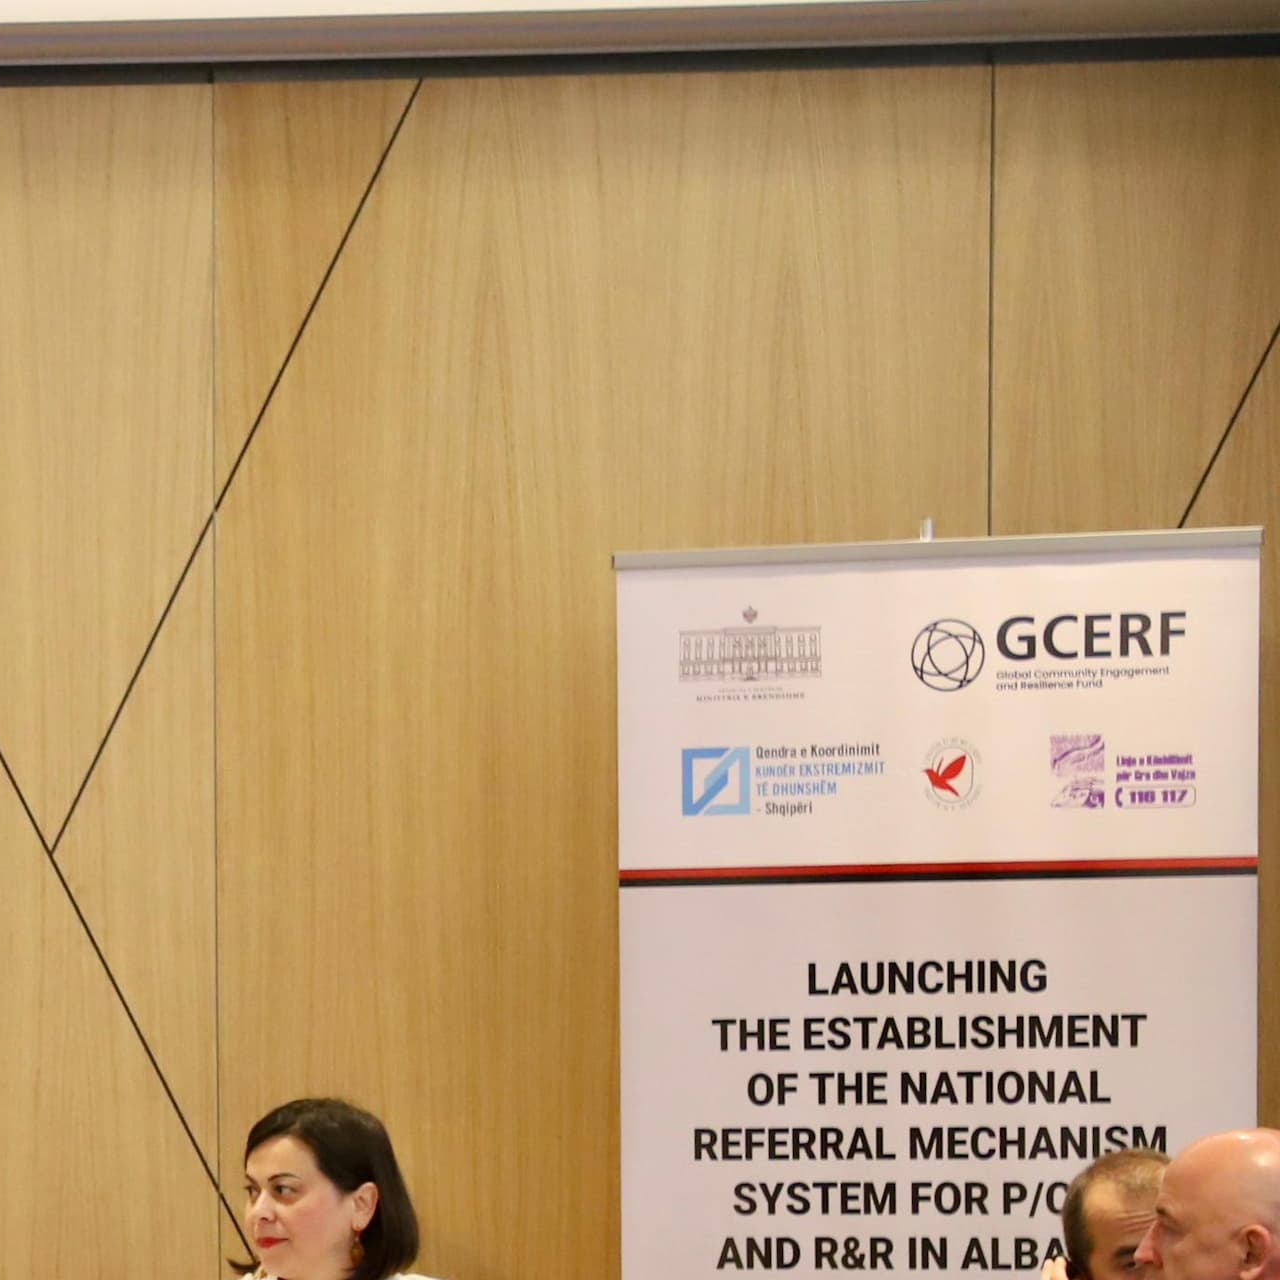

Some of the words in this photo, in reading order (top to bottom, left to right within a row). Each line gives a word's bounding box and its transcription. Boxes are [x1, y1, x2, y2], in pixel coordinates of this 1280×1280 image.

[996, 611, 1186, 661] GCERF
[996, 668, 1032, 680] Global
[1034, 667, 1098, 679] Community
[1100, 666, 1169, 679] Engagement
[996, 680, 1017, 691] and
[1020, 680, 1074, 690] Resilience
[1076, 679, 1103, 688] Fund
[756, 745, 796, 759] Qendra
[800, 748, 807, 758] e
[810, 742, 880, 757] Koordinimit
[800, 761, 885, 776] EKSTREMIZMIT
[756, 781, 768, 796] TË
[772, 780, 837, 796] DHUNSHËM
[1161, 790, 1188, 803] 117
[765, 801, 813, 816] Shqipëri
[807, 959, 1048, 995] LAUNCHING
[711, 1017, 791, 1051] THE
[803, 1013, 1148, 1050] ESTABLISHMENT
[747, 1072, 799, 1107] OF
[809, 1071, 888, 1105] THE
[900, 1070, 1111, 1104] NATIONAL
[693, 1127, 896, 1161] REFERRAL
[909, 1125, 1168, 1159] MECHANISM
[732, 1181, 896, 1216] SYSTEM
[911, 1181, 989, 1215] FOR
[716, 1237, 801, 1271] AND
[814, 1236, 894, 1270] R&R
[908, 1237, 948, 1270] IN
